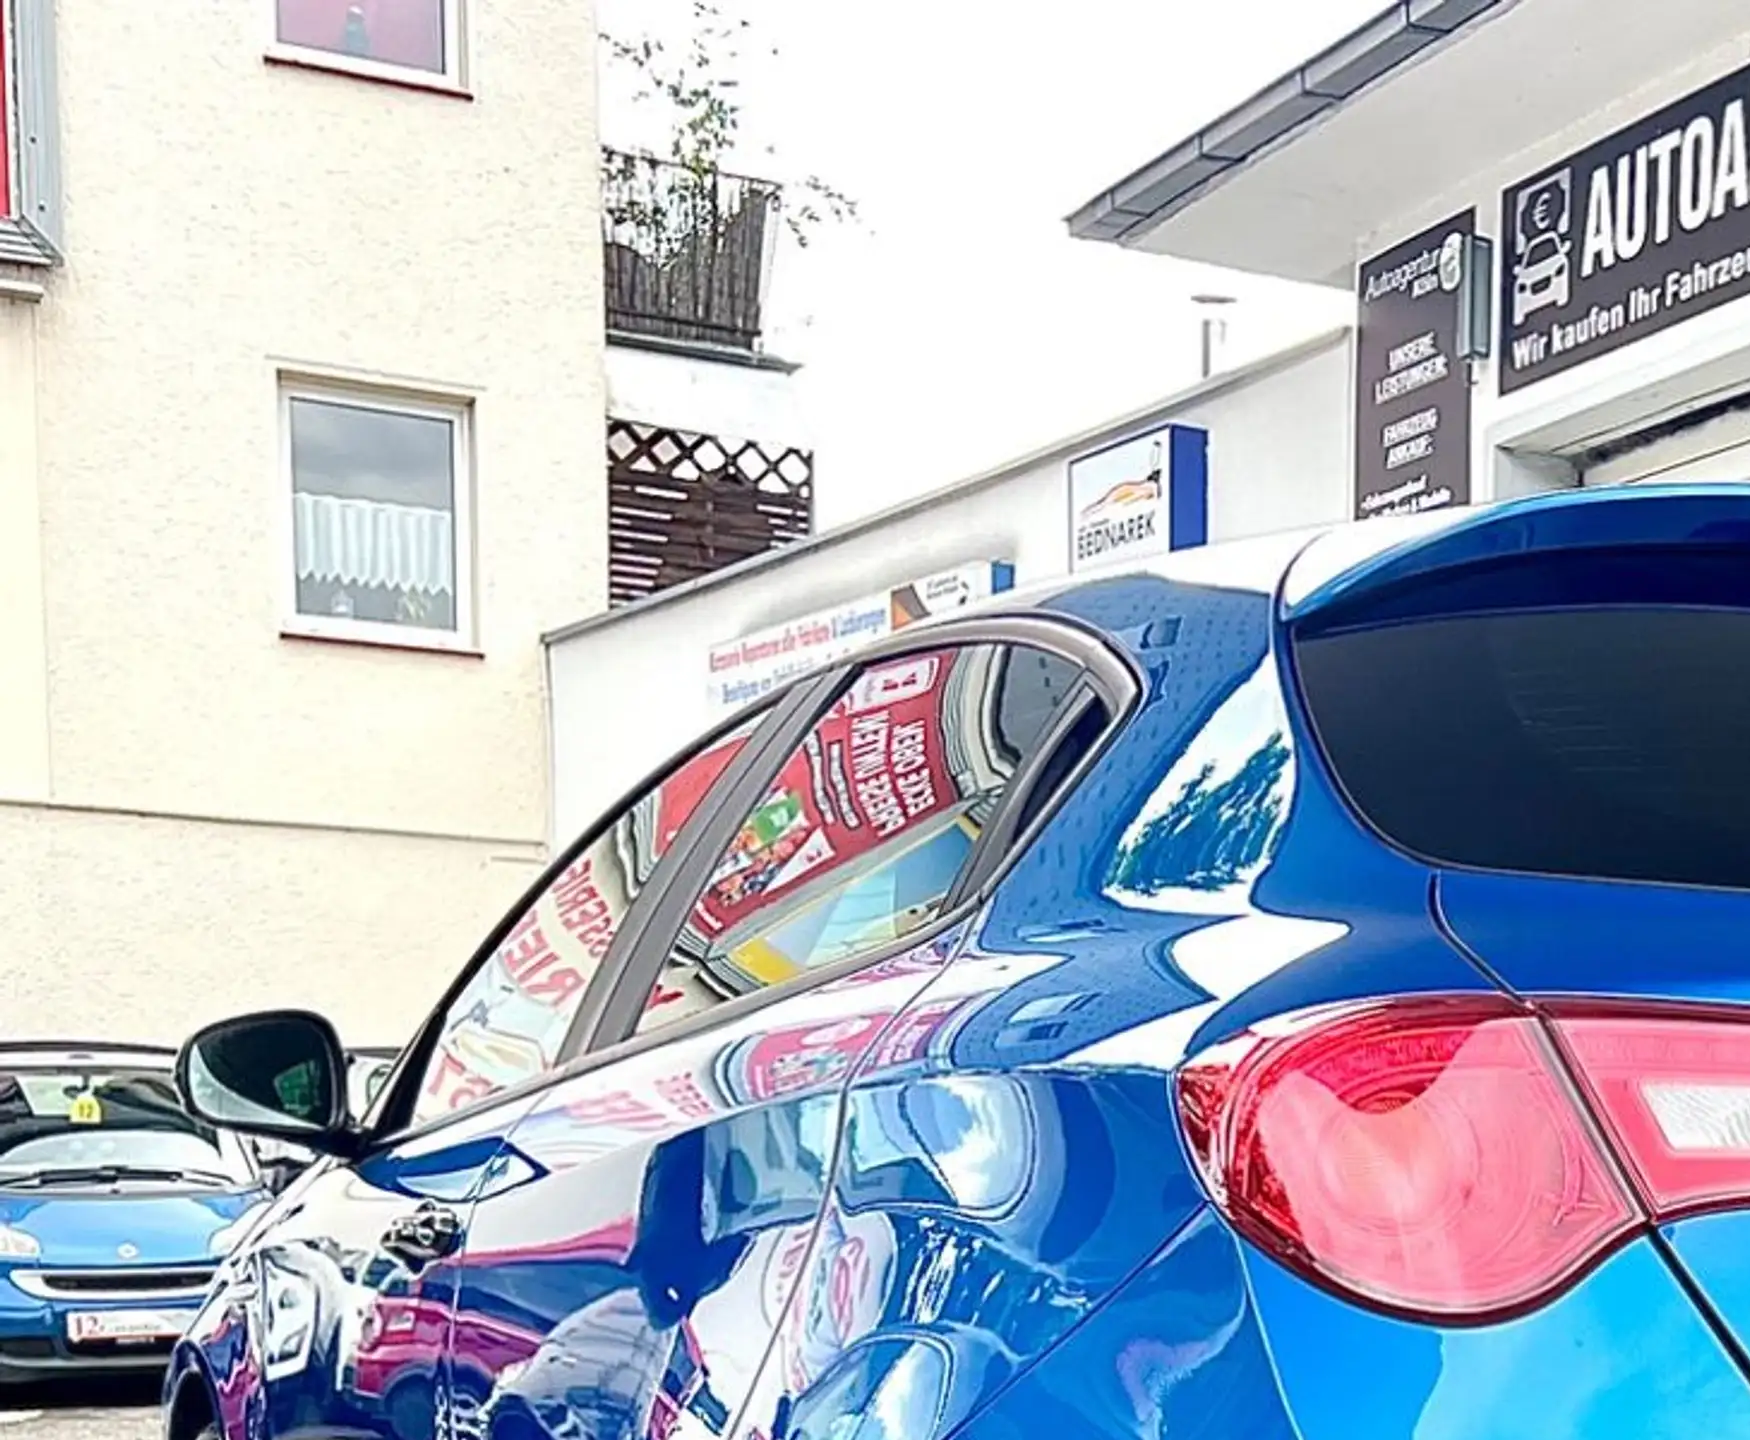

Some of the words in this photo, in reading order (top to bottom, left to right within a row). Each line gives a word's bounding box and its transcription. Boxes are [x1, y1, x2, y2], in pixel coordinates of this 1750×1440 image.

[1513, 332, 1549, 371] Wir
[1552, 303, 1625, 355] kaufen
[1629, 286, 1664, 323] Ihr
[1077, 509, 1156, 561] BEDNAREK
